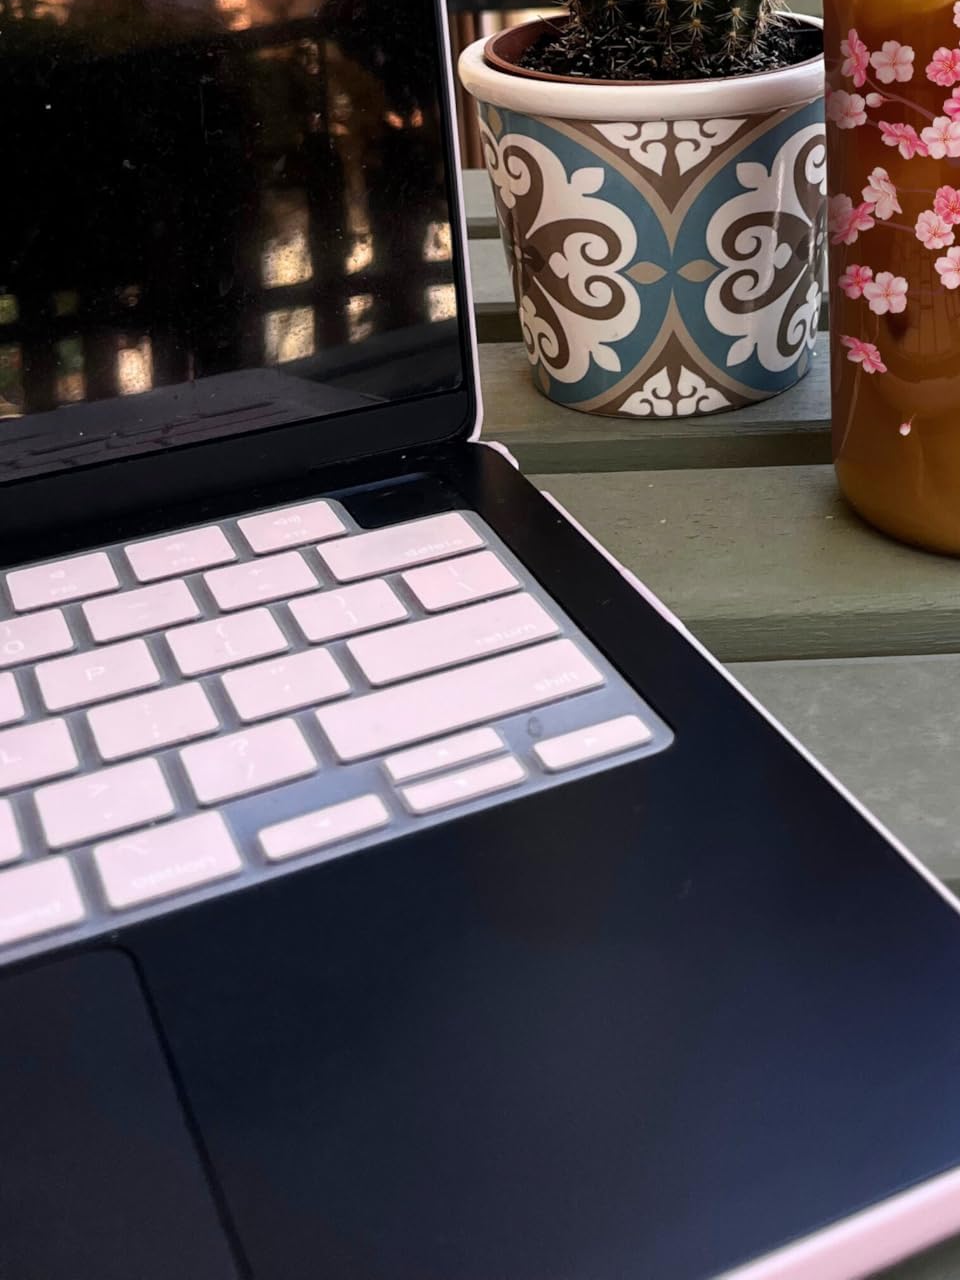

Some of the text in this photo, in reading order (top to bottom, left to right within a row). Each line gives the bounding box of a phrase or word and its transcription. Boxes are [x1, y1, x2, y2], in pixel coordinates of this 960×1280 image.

[474, 623, 538, 647] return
[84, 665, 105, 681] P
[532, 671, 579, 693] shift
